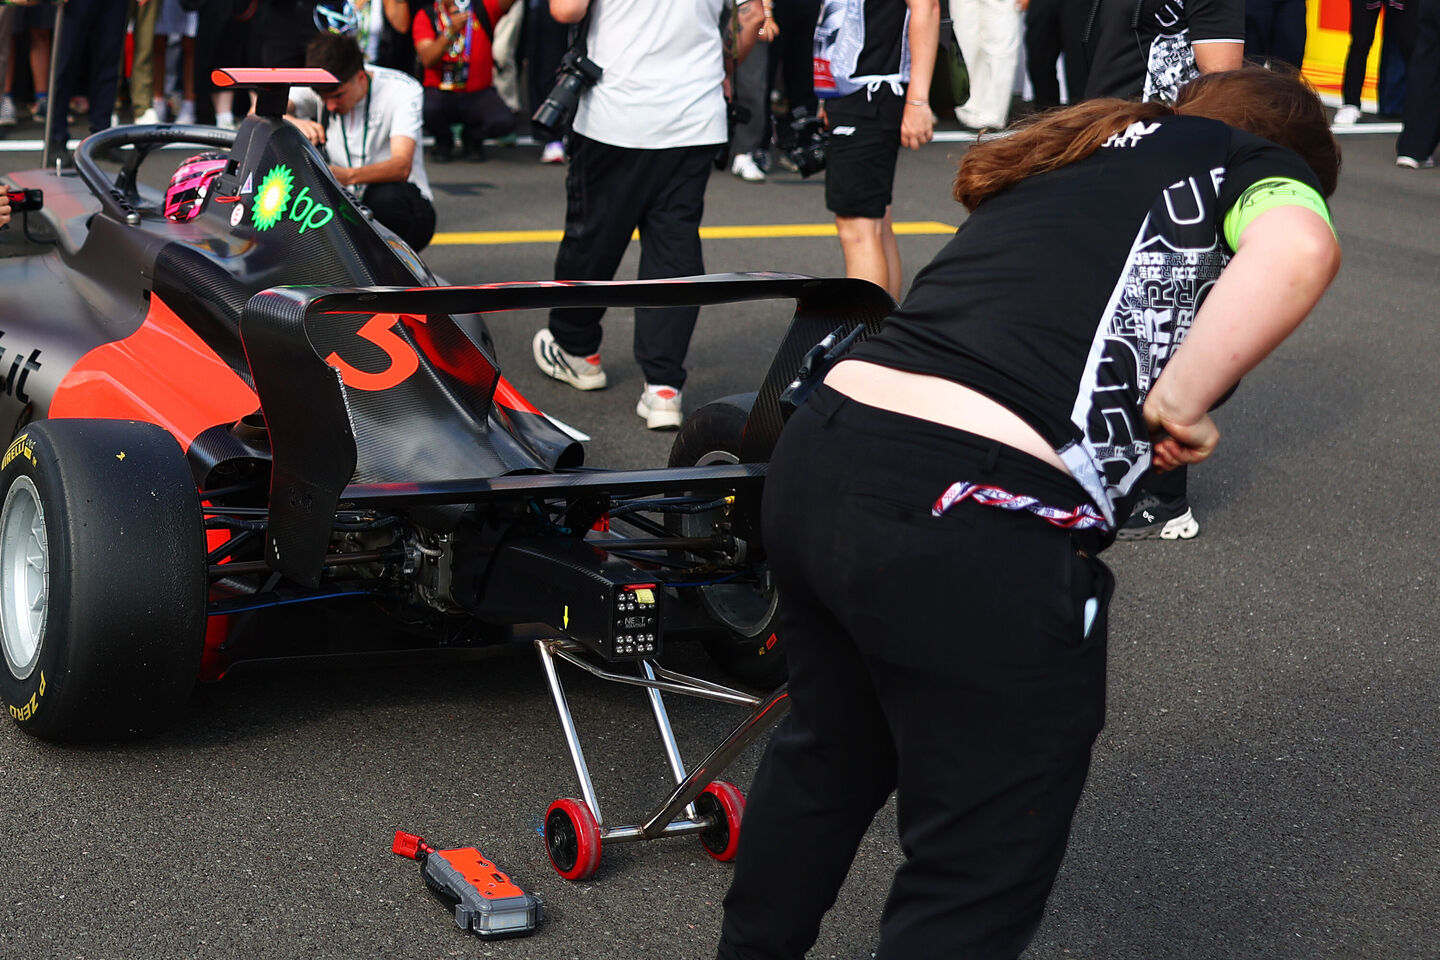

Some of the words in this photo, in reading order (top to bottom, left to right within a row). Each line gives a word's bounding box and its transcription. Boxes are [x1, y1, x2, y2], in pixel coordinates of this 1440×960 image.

[288, 186, 334, 234] bp
[324, 312, 426, 392] 3
[0, 433, 29, 471] PIRELLI
[38, 669, 47, 697] P
[9, 691, 39, 721] ZERO
